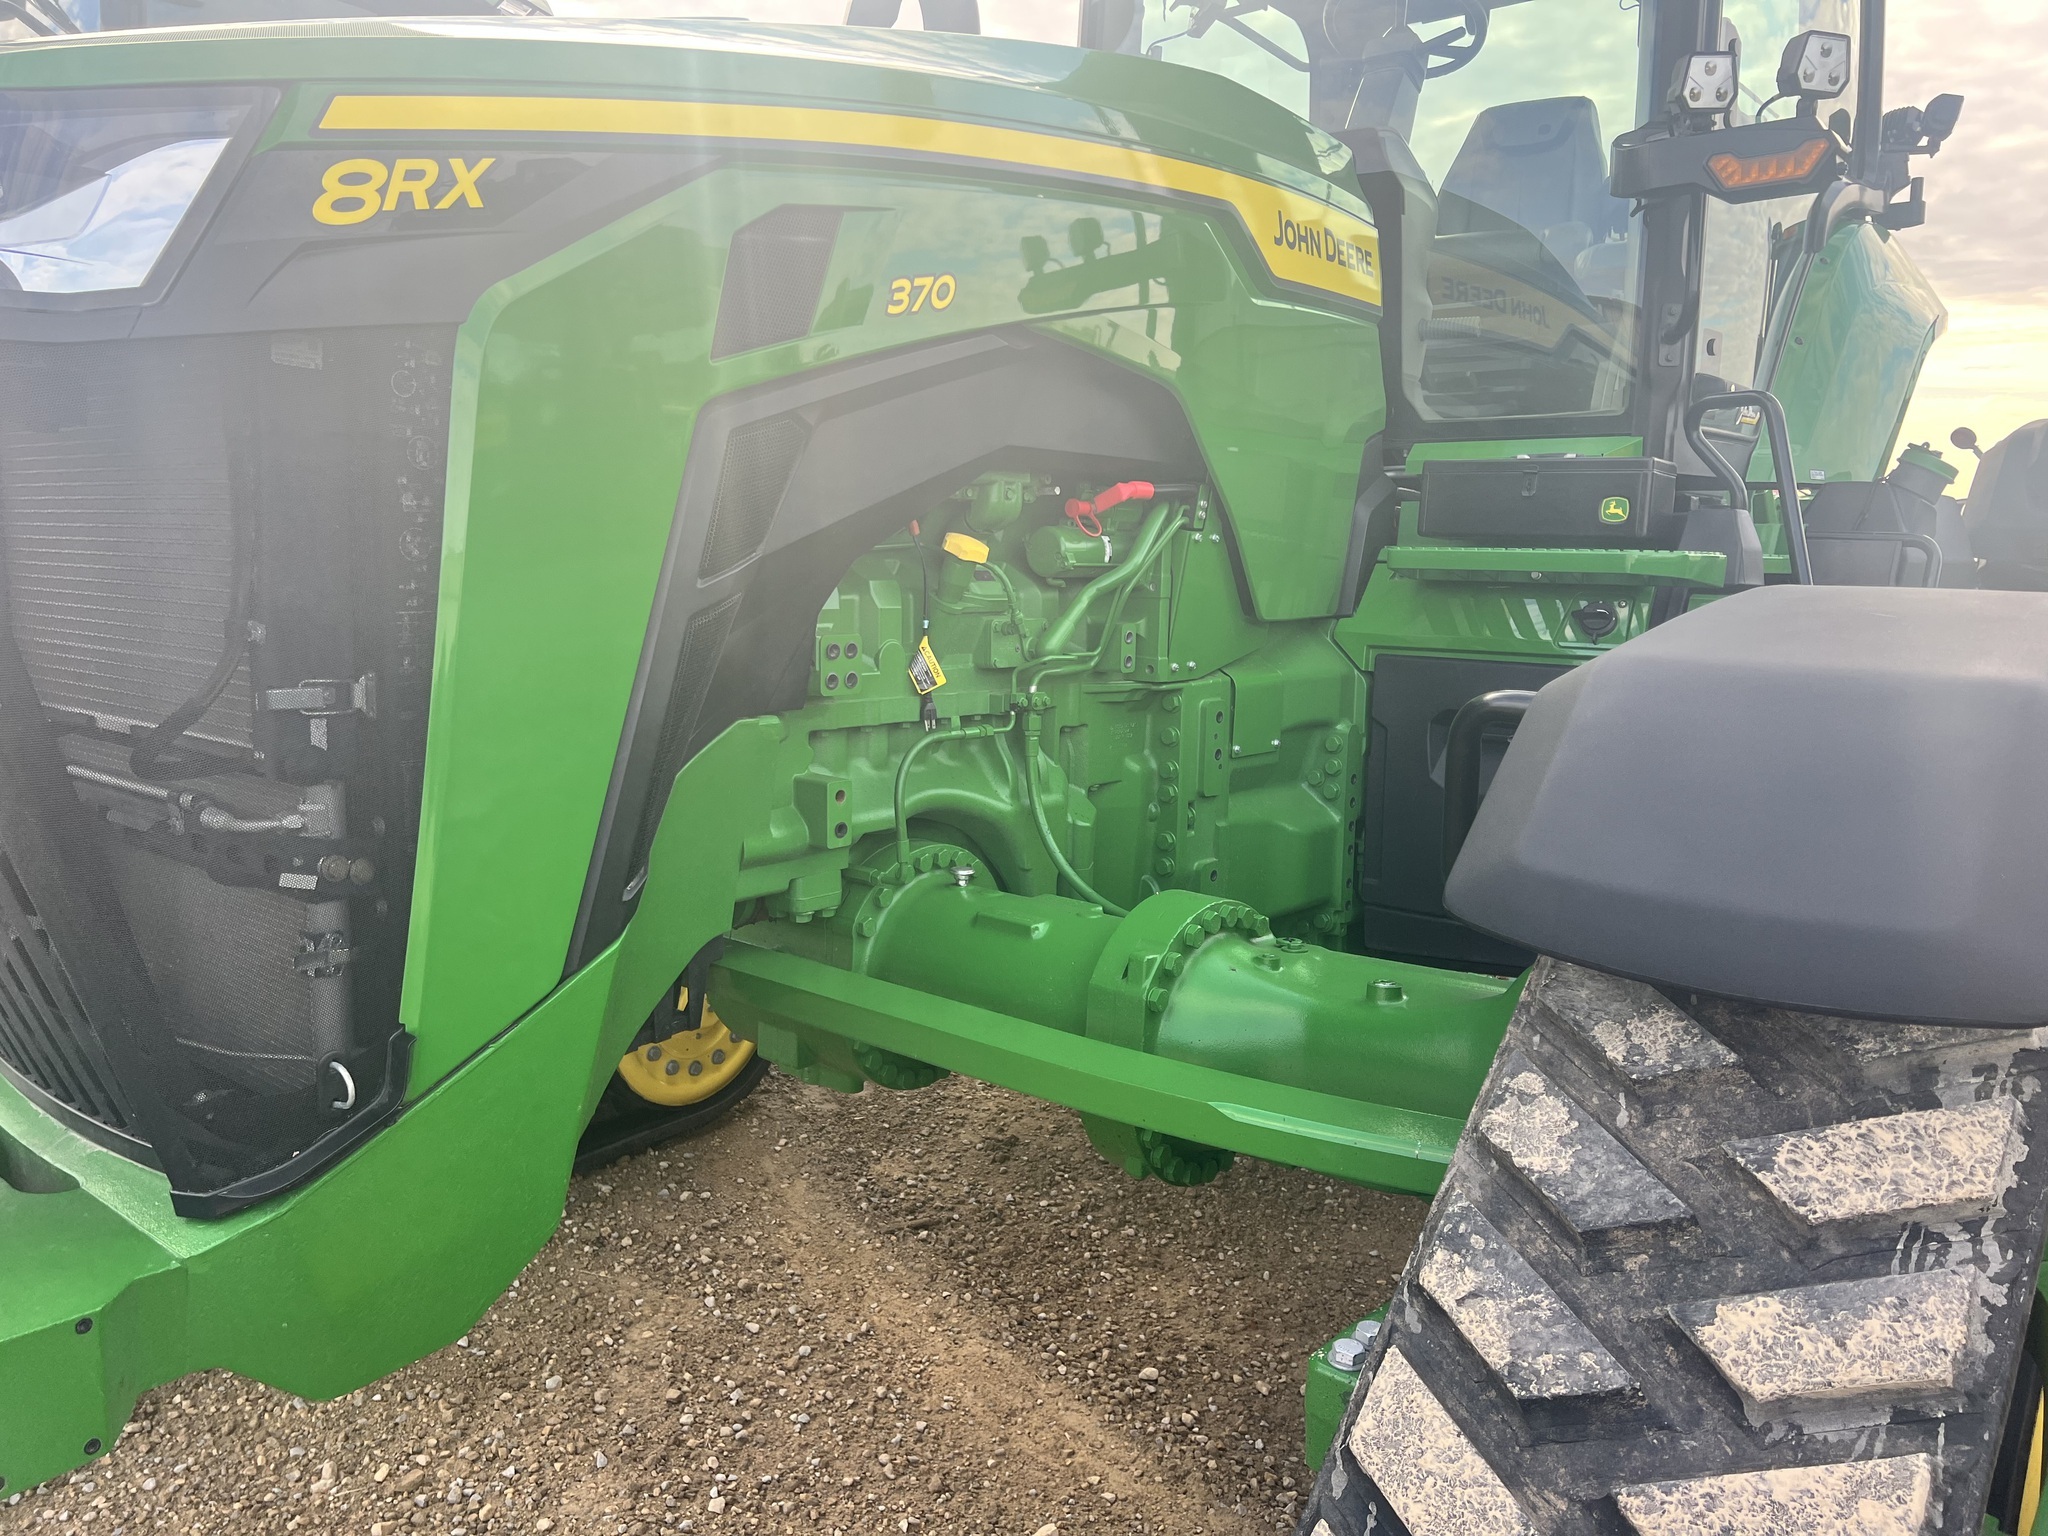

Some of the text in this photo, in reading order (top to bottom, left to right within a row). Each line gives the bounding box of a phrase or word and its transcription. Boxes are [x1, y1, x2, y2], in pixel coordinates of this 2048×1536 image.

[312, 158, 496, 225] 8RX
[1273, 209, 1375, 278] JOHN DEERE
[886, 274, 956, 315] 370
[924, 650, 941, 678] CAUTION
